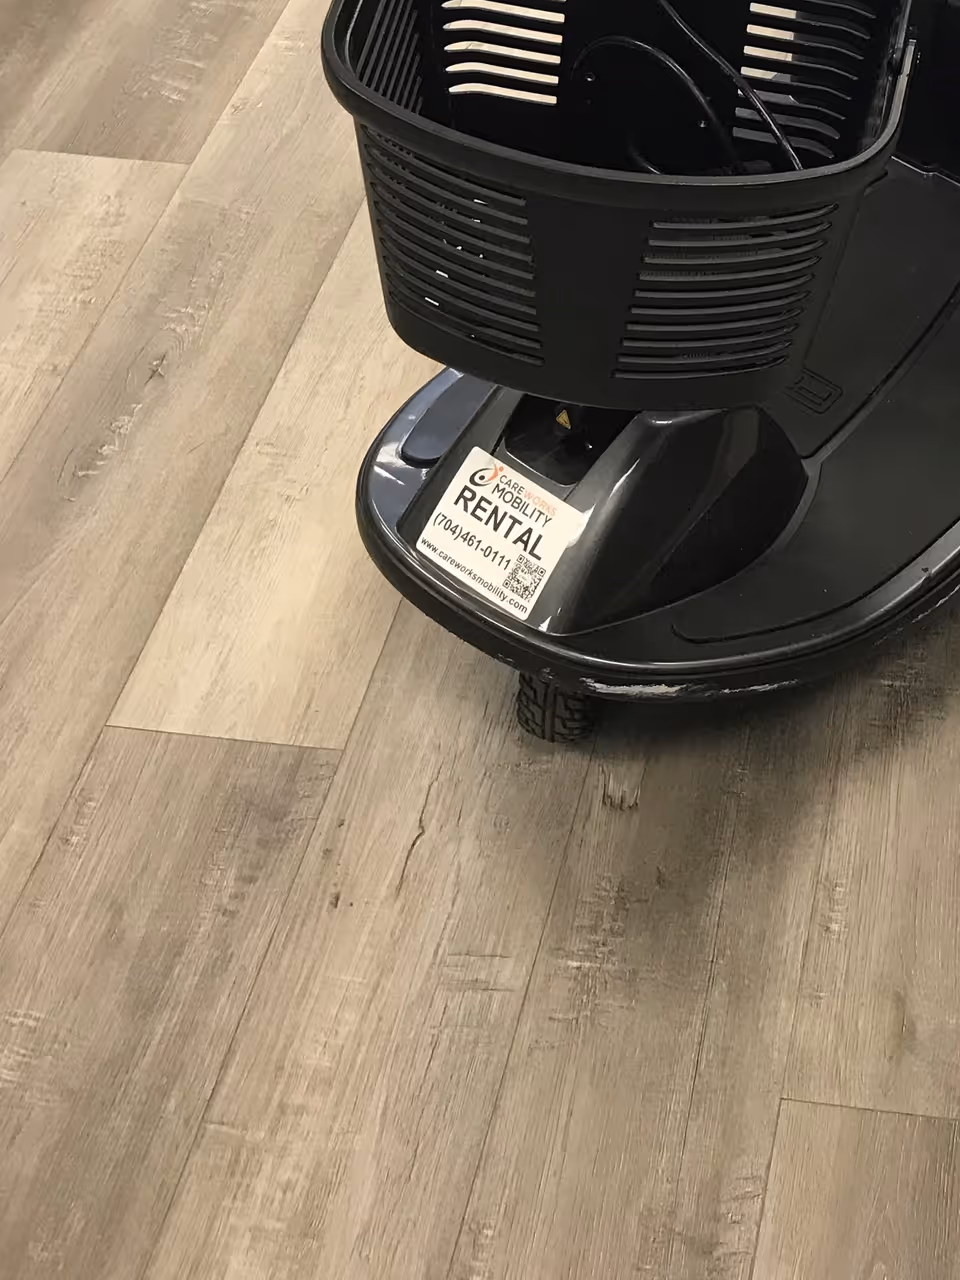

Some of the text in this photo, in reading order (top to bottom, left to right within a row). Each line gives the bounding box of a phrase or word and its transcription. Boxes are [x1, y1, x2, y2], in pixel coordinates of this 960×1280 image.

[454, 485, 544, 561] RENTAL
[491, 483, 553, 527] MOBILITY
[420, 536, 528, 614] www.careworksmobility.com
[432, 512, 511, 571] (704)461-0111
